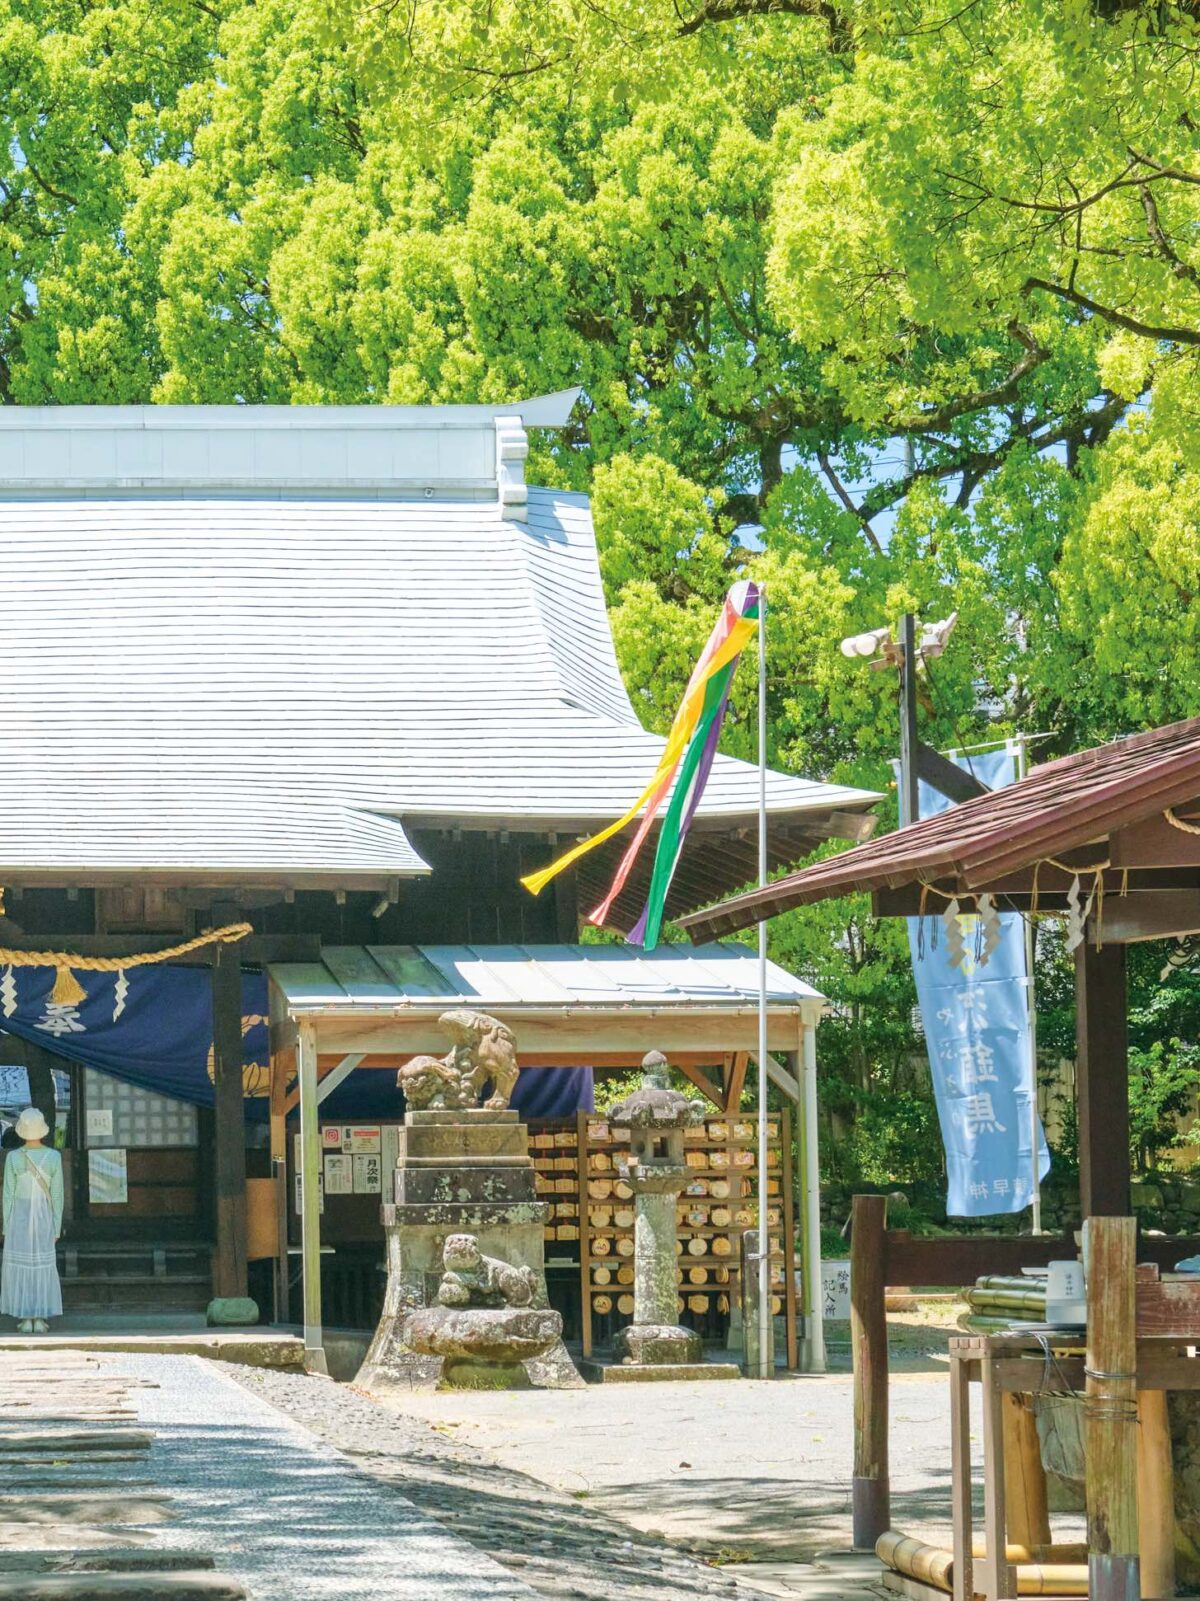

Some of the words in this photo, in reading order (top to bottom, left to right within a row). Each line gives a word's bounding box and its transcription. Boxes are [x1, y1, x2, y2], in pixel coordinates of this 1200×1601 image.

[366, 1159, 378, 1184] 月次祭
[838, 1270, 849, 1295] 絵馬
[823, 1279, 836, 1317] 記入所
